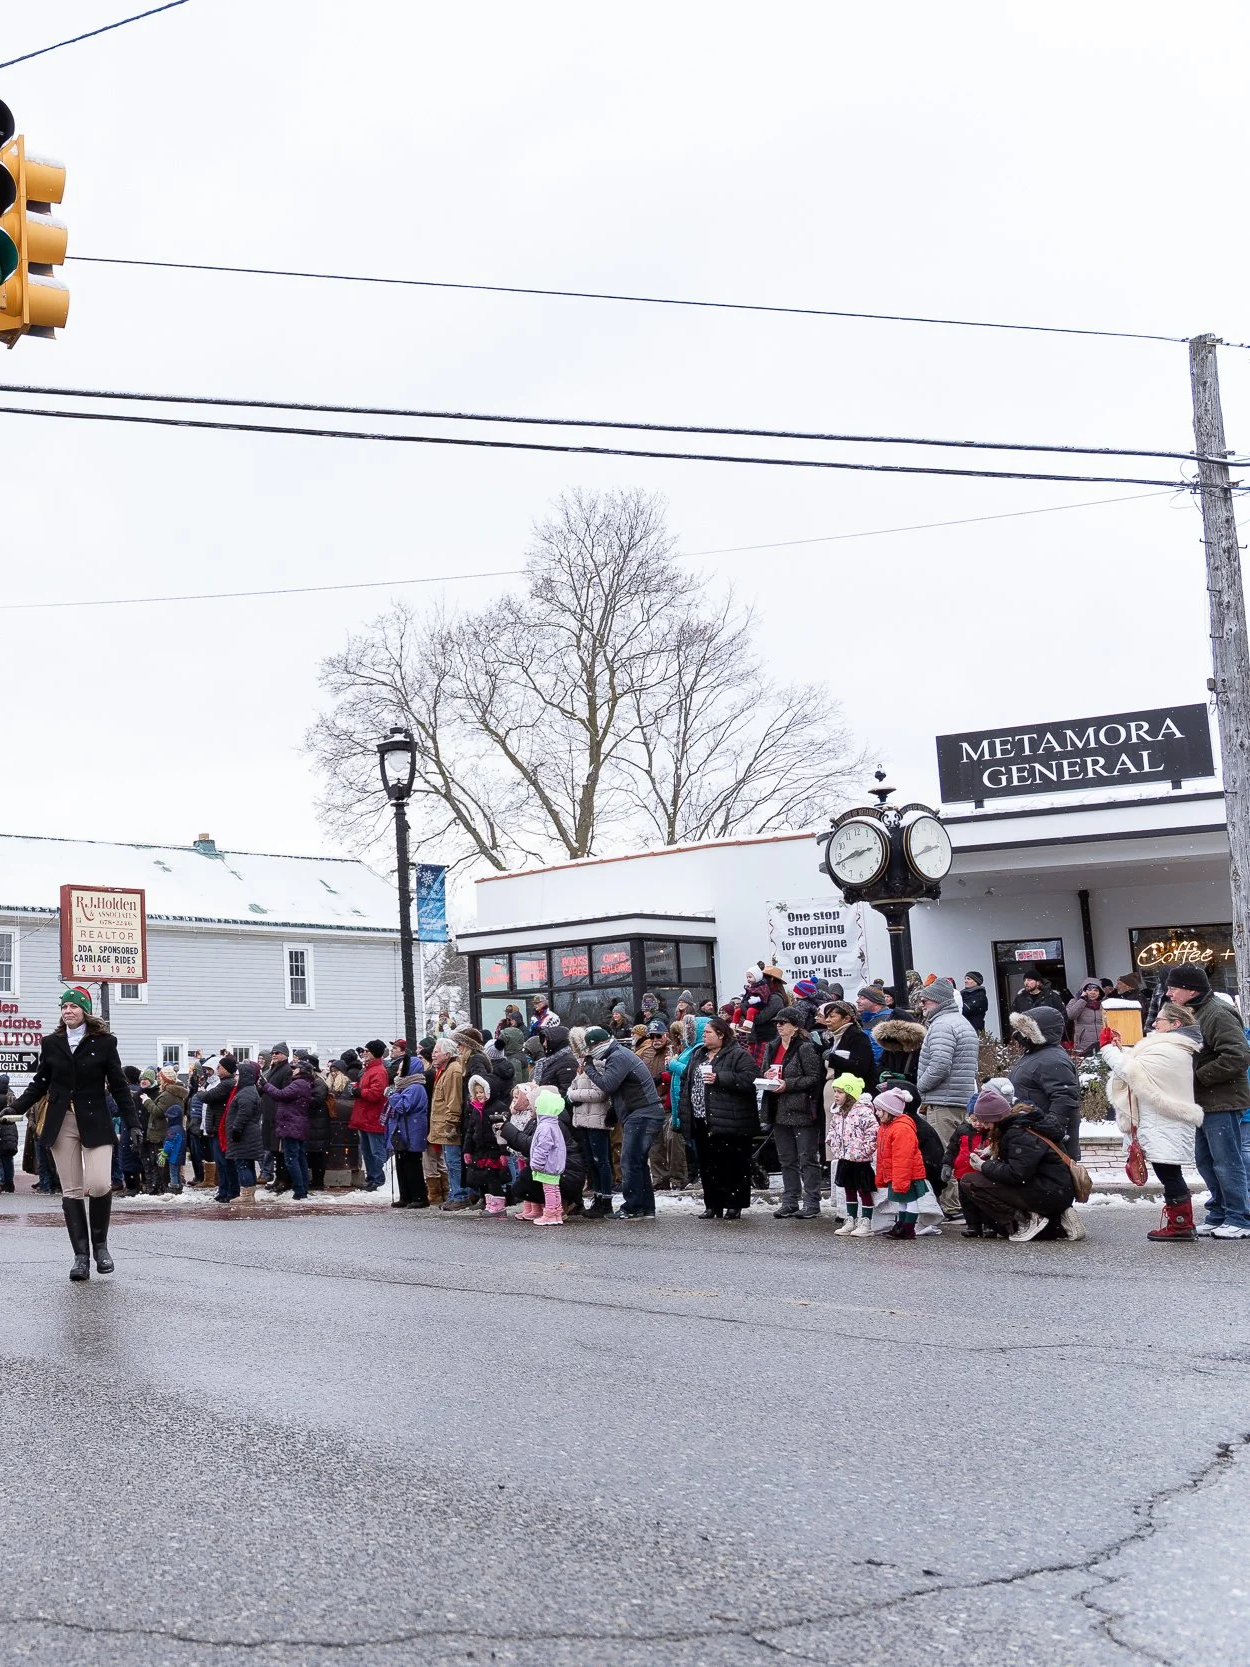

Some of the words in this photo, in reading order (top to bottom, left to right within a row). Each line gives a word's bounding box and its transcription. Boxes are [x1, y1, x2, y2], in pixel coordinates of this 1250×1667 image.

[959, 717, 1185, 763] METAMORA
[982, 750, 1165, 788] GENERAL
[787, 912, 810, 922] One
[813, 910, 840, 921] stop
[80, 930, 134, 940] REALTOR
[787, 924, 845, 936] shopping
[78, 944, 93, 953] DDA
[99, 946, 138, 955] SPONSORED
[782, 941, 796, 951] for
[798, 939, 847, 952] everyone
[74, 954, 111, 963] CARRIAGE
[114, 956, 136, 964] RIDES
[1018, 951, 1044, 960] OPEN
[1137, 941, 1213, 966] Coffee
[794, 955, 808, 965] on
[811, 954, 837, 965] your
[786, 968, 821, 979] "nice"
[823, 968, 852, 978] list...
